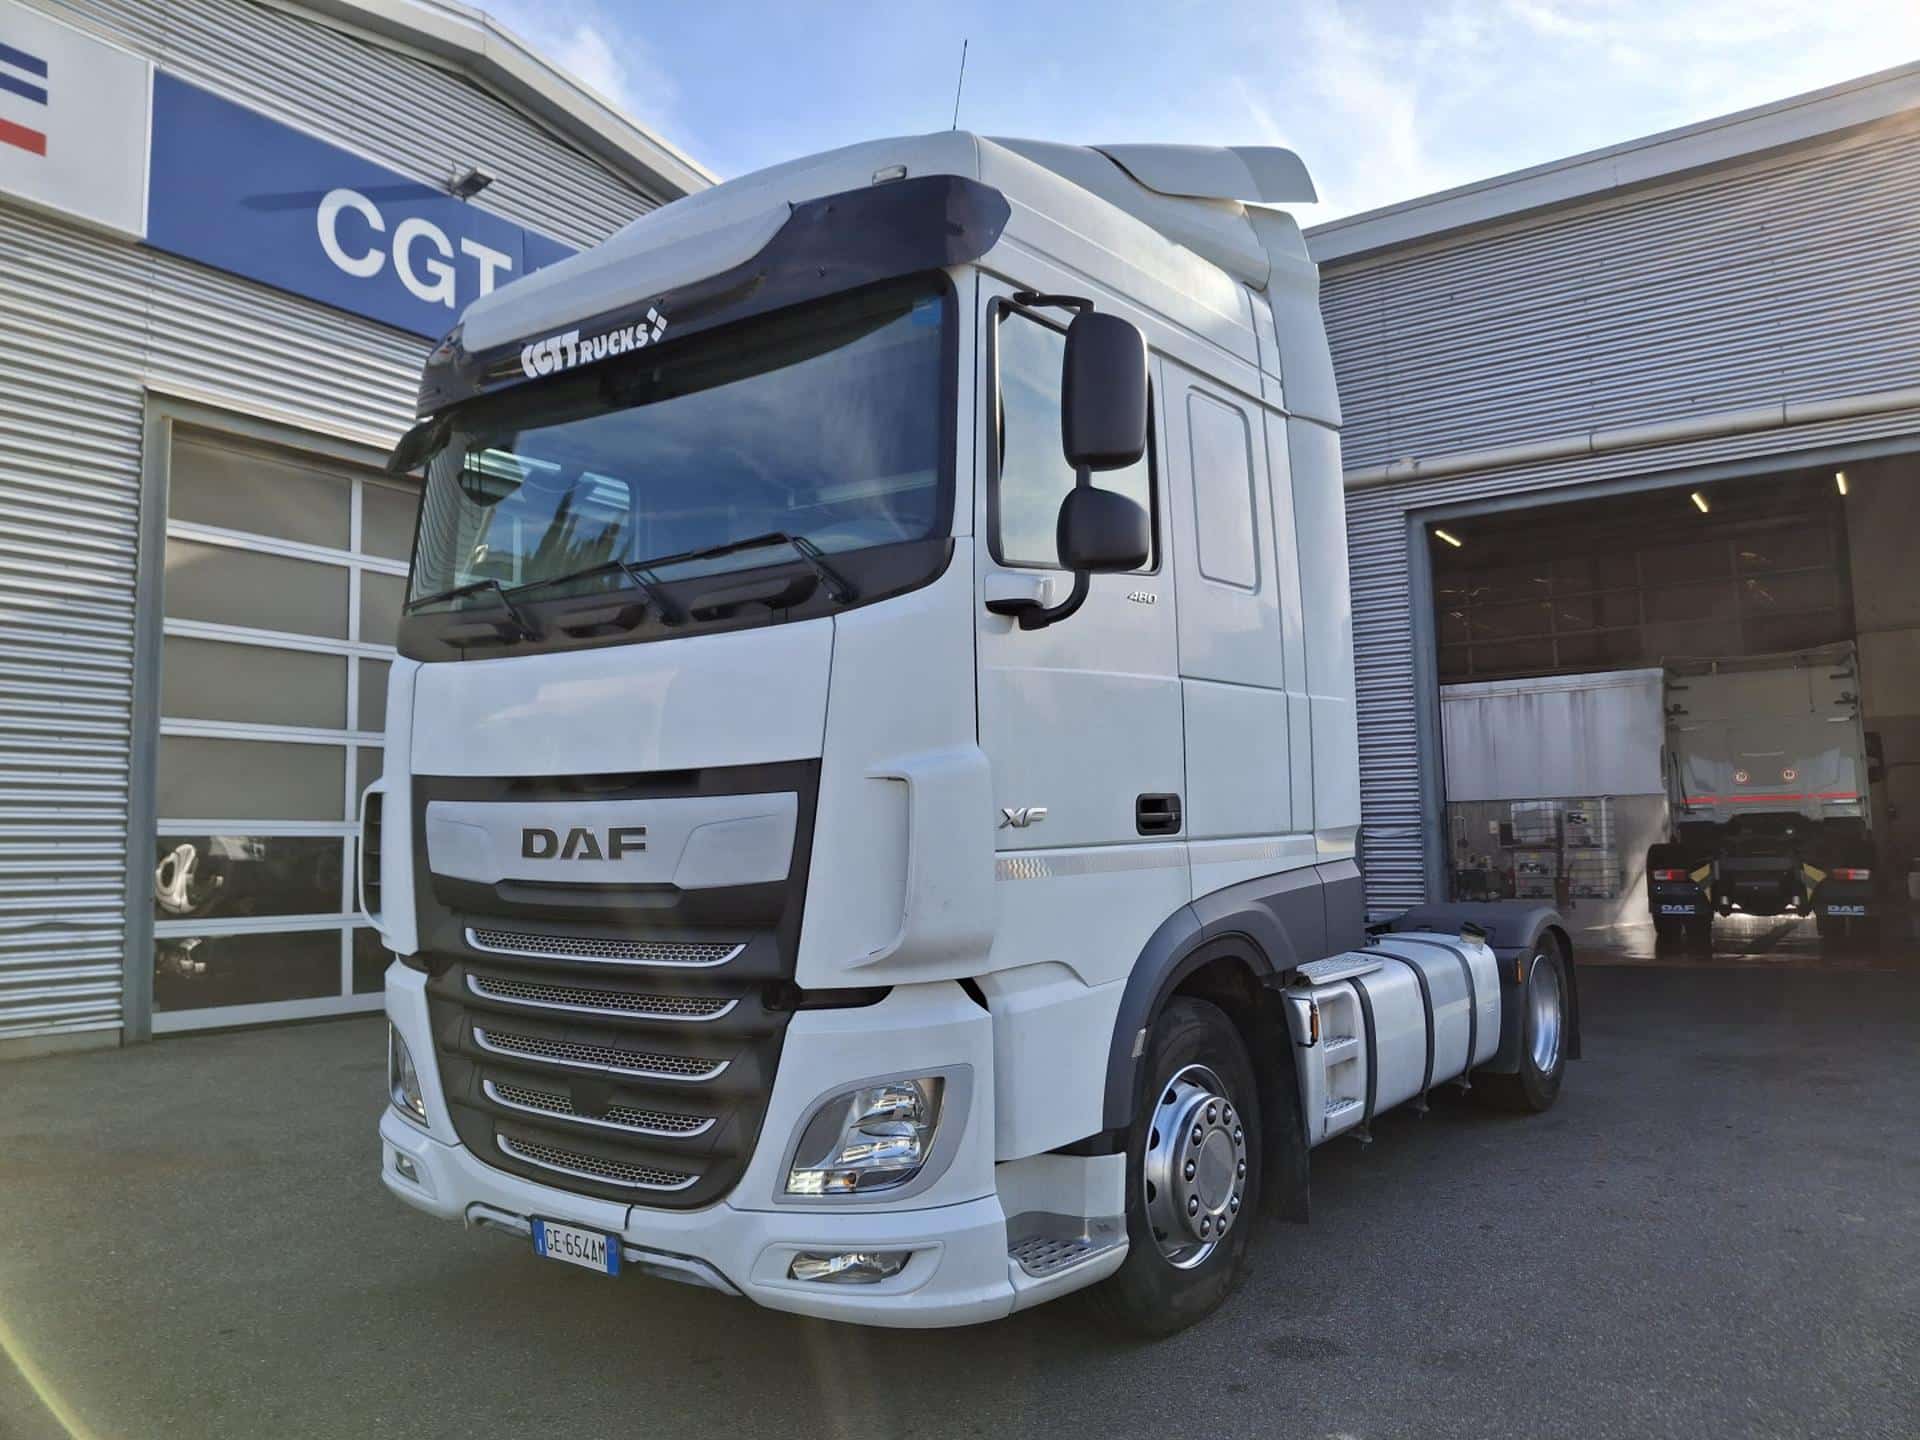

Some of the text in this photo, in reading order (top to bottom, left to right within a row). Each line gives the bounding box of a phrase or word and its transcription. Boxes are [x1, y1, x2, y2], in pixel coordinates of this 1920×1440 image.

[317, 188, 512, 309] CGT
[999, 807, 1048, 829] XF
[521, 826, 647, 861] DAF
[1827, 904, 1865, 913] DAF
